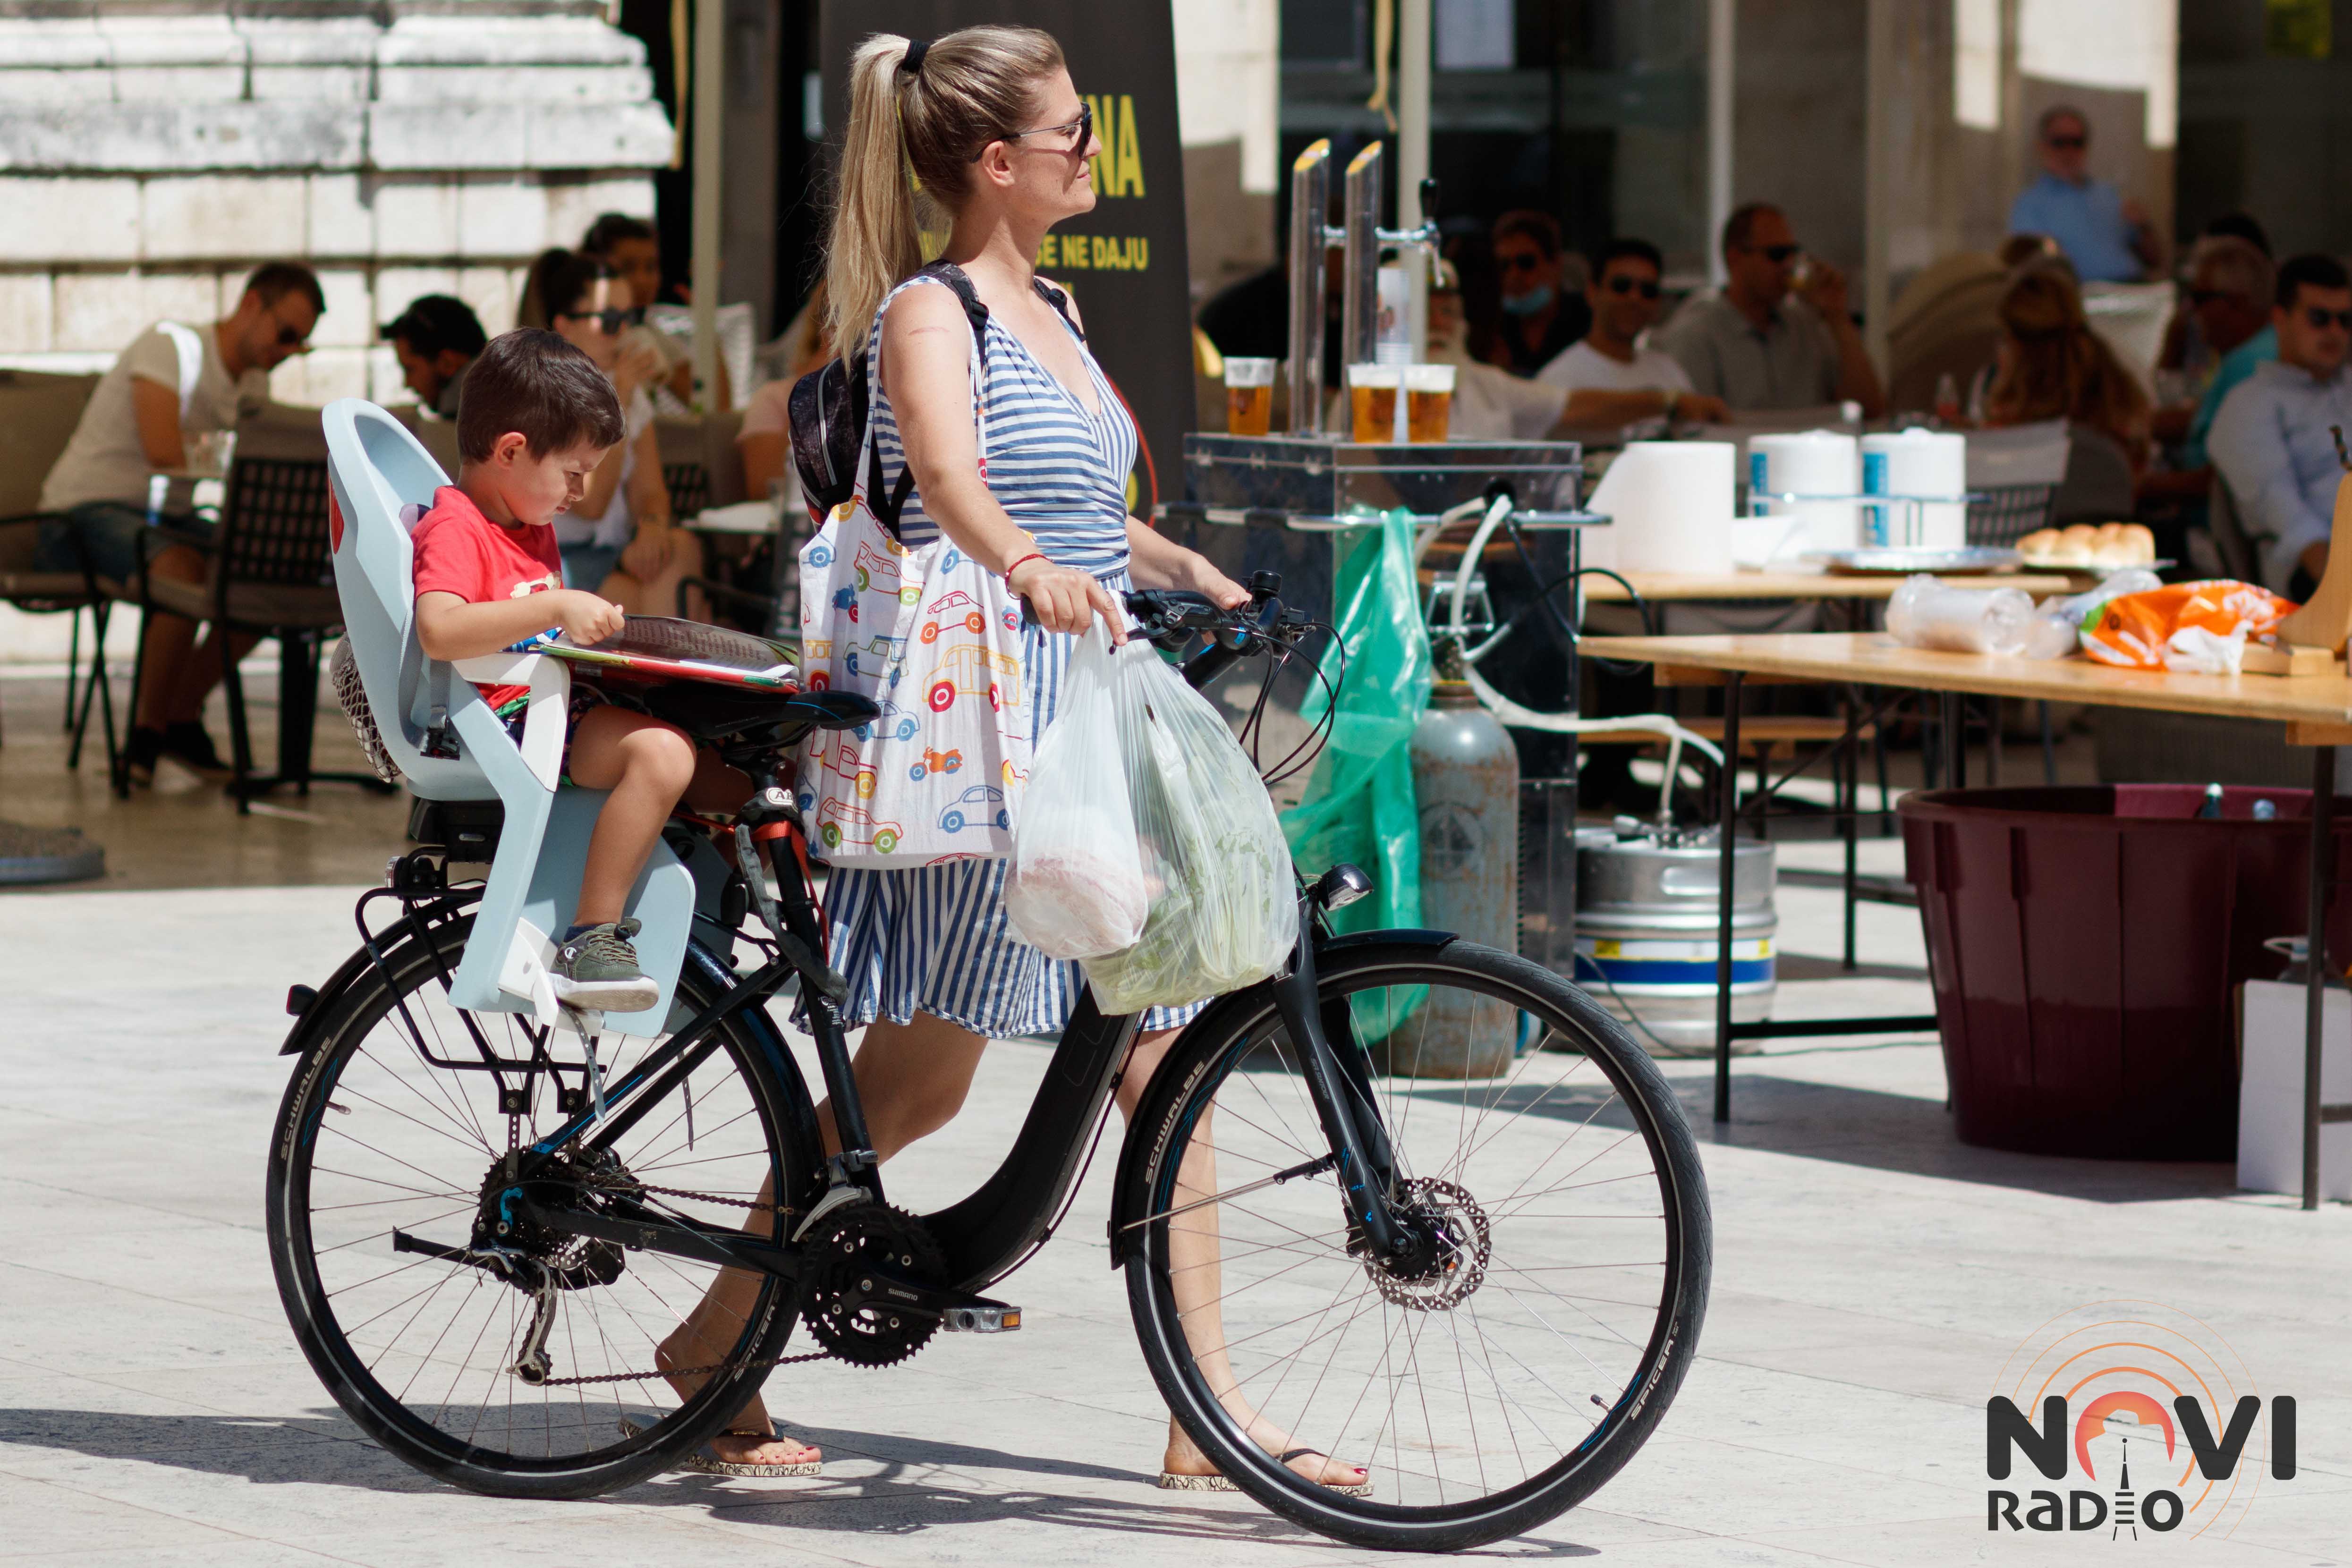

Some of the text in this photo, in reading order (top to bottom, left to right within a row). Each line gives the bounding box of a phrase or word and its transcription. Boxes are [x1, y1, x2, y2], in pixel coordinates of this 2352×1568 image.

[1077, 94, 1145, 197] NA
[1062, 235, 1089, 268] NE
[1093, 236, 1148, 271] DAJU
[281, 1036, 331, 1160] SCHWALBE
[1145, 1061, 1204, 1184] SCHWALBE
[888, 1288, 918, 1301] SHIMANO
[734, 1305, 775, 1382] SPICER
[1630, 1339, 1673, 1420] SPICER
